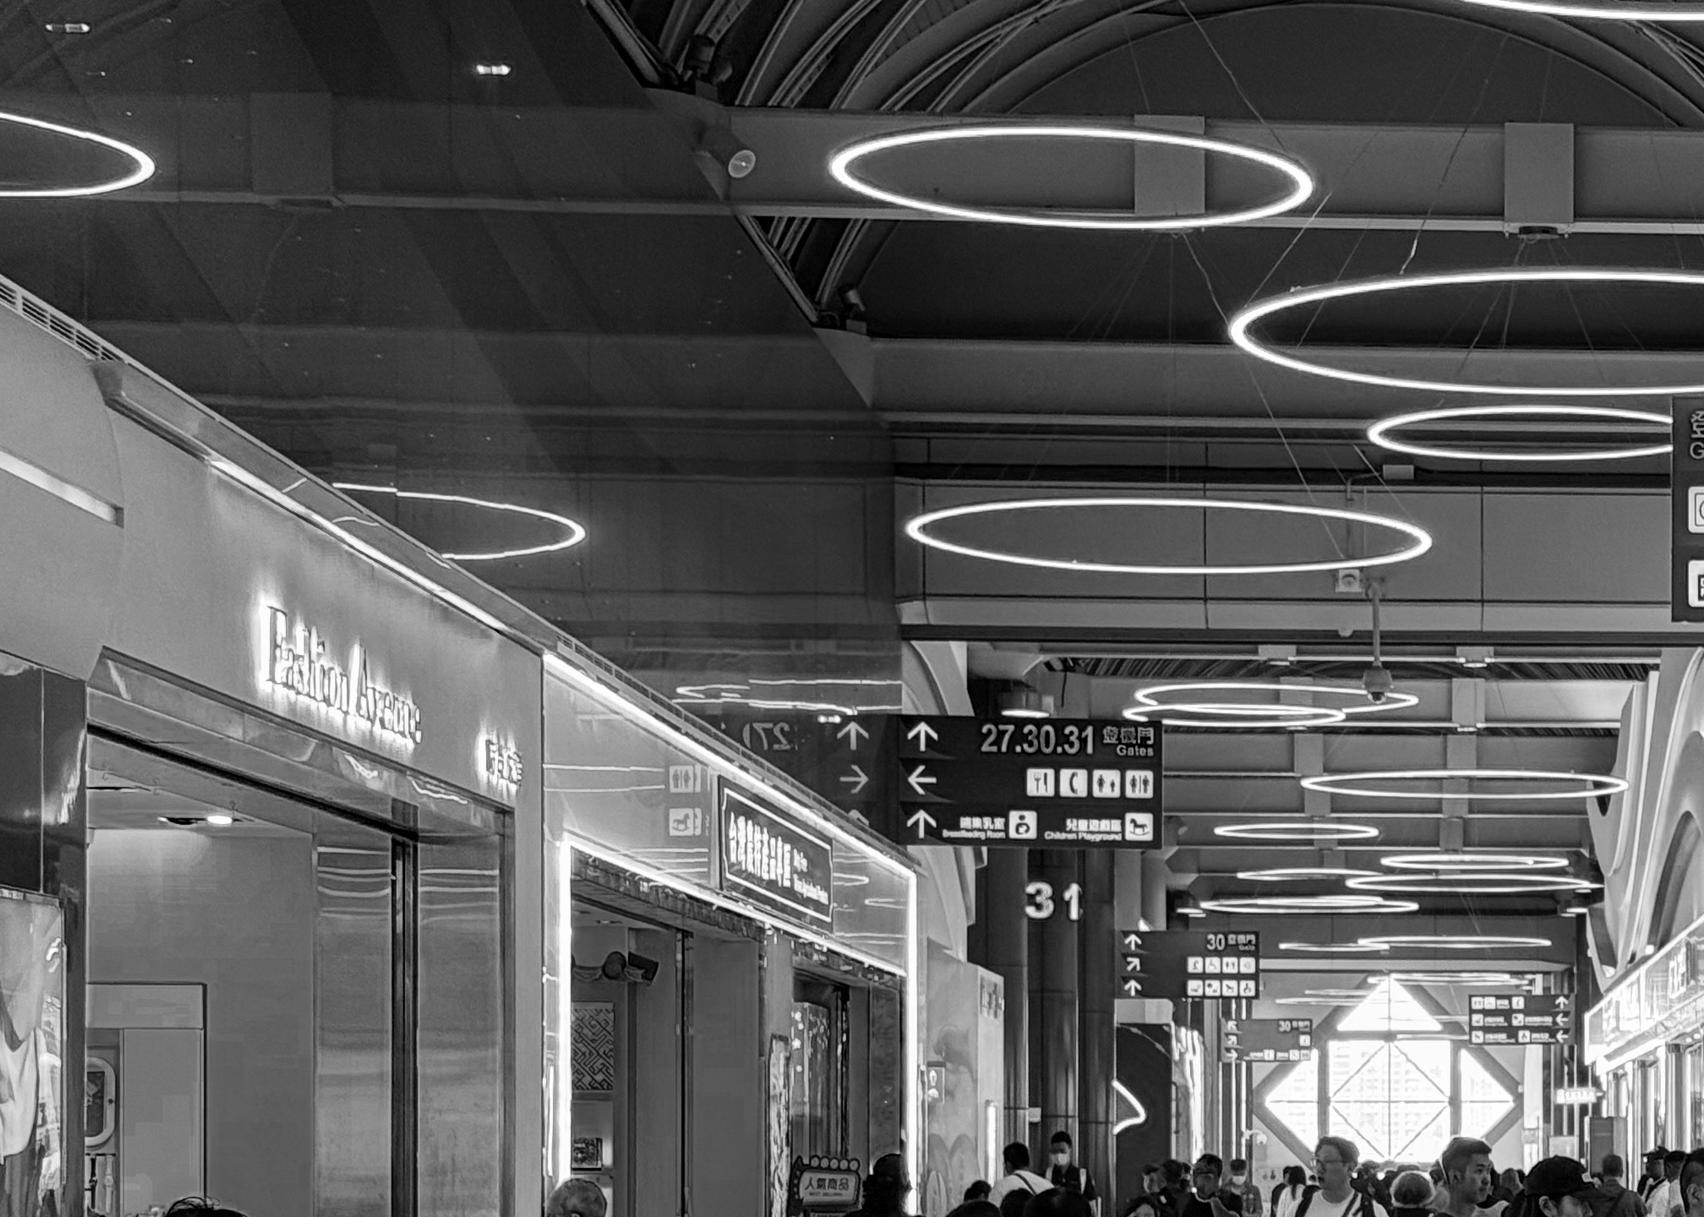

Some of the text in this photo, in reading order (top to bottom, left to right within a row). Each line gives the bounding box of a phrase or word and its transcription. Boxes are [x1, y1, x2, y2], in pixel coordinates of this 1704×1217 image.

[260, 604, 349, 714] Fashion
[981, 724, 1094, 755] 27.30.31
[1116, 744, 1154, 757] Gates
[1044, 831, 1078, 841] Children
[1025, 882, 1083, 922] 31
[1206, 934, 1225, 951] 30
